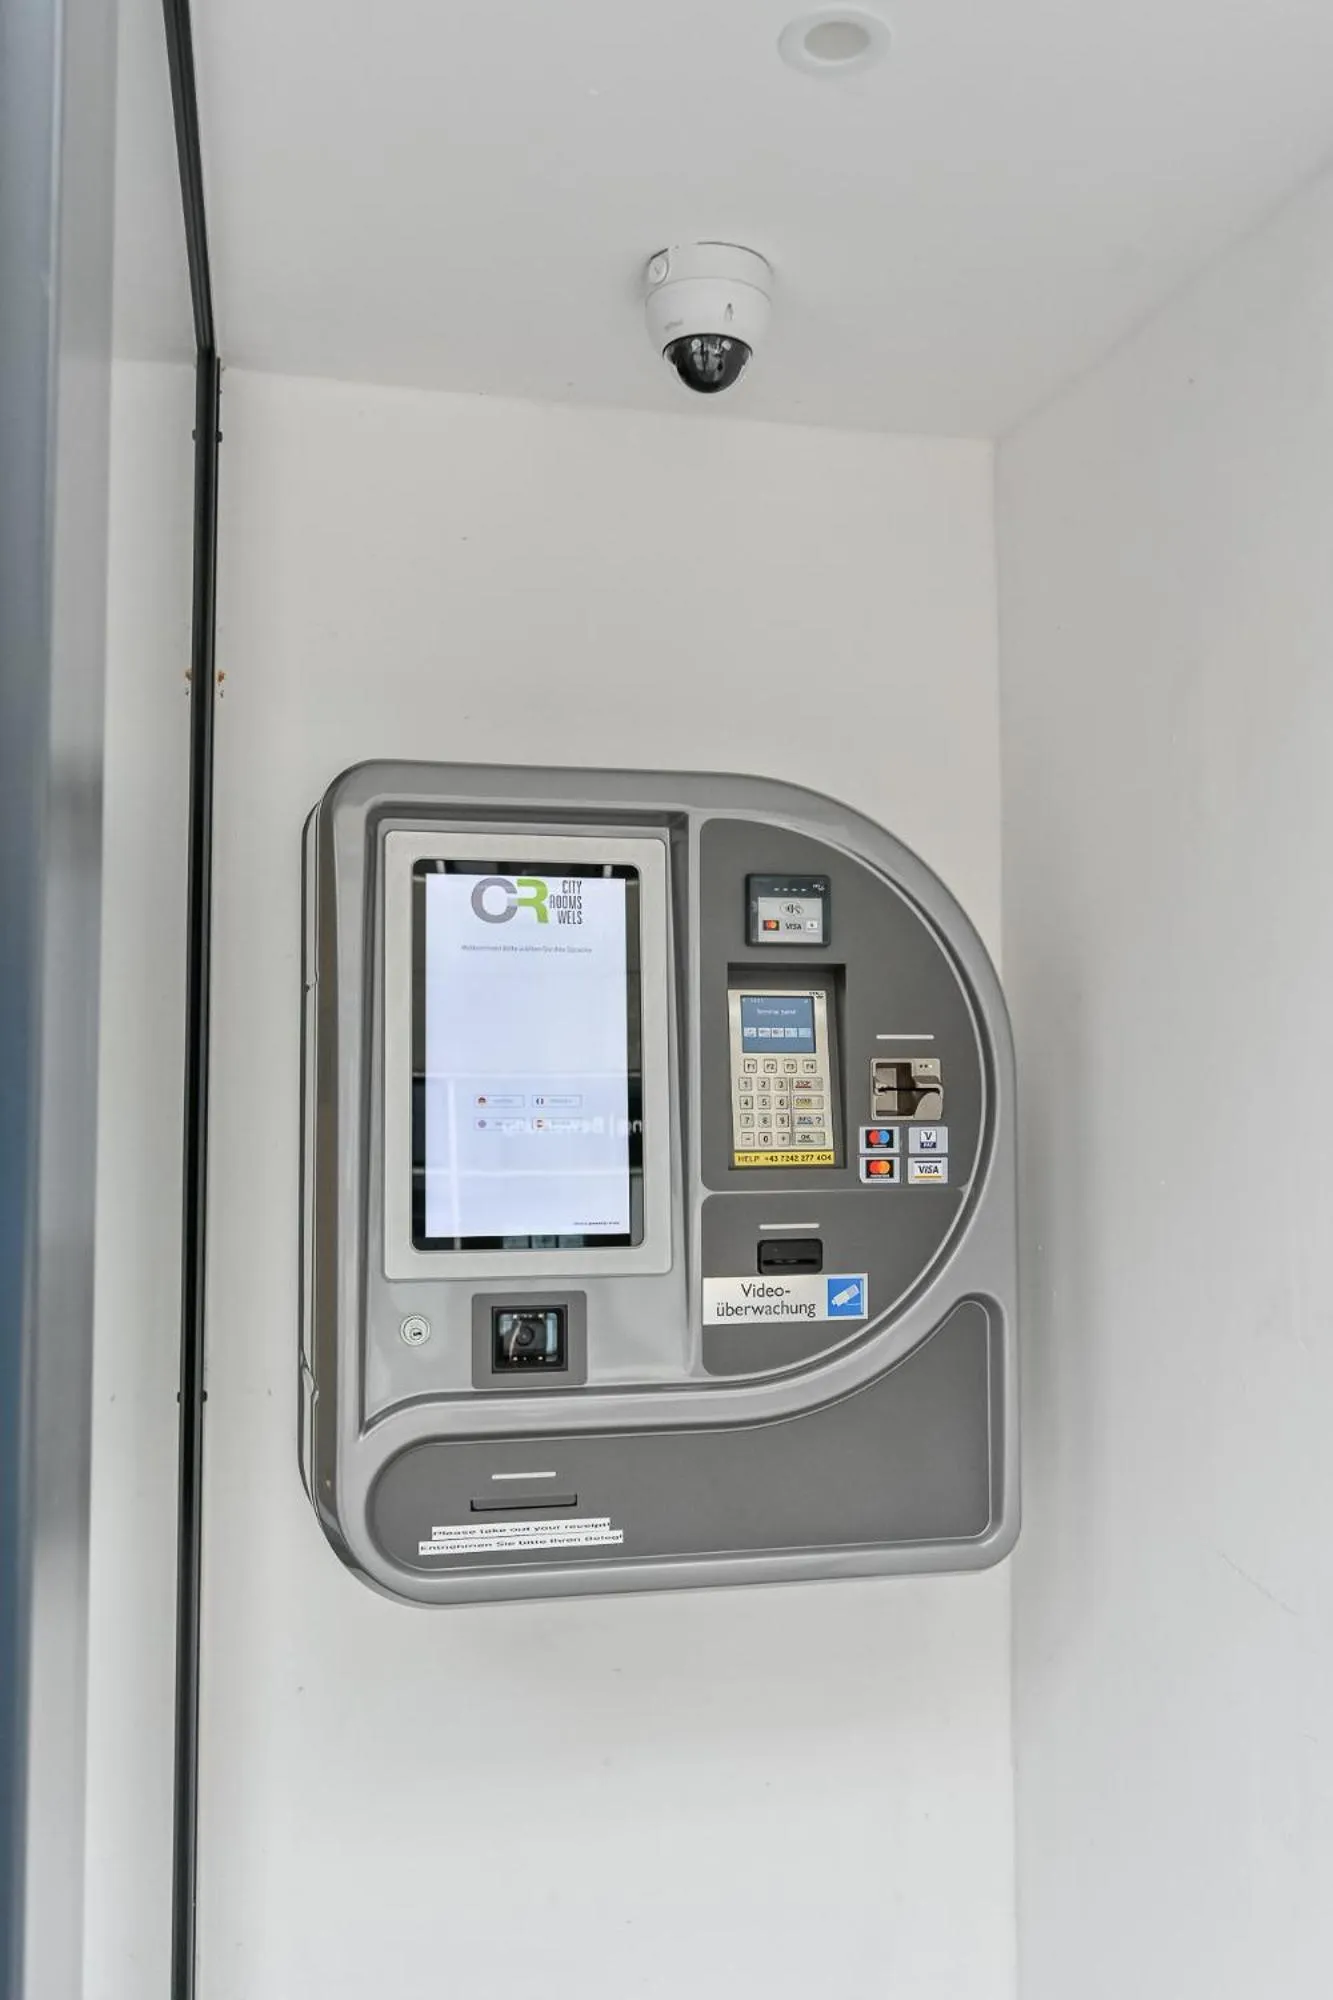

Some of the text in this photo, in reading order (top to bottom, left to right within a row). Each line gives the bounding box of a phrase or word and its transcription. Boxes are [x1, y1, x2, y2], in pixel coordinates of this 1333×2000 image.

[562, 880, 582, 894] CITY
[549, 895, 583, 909] ROOMS
[557, 911, 583, 925] WELS
[923, 1131, 933, 1141] V
[917, 1165, 939, 1174] VISA
[741, 1283, 791, 1298] Video-
[716, 1301, 817, 1318] überwachung
[433, 1529, 477, 1537] Please
[480, 1527, 507, 1535] take
[534, 1525, 561, 1533] your
[496, 1540, 516, 1548] Sie
